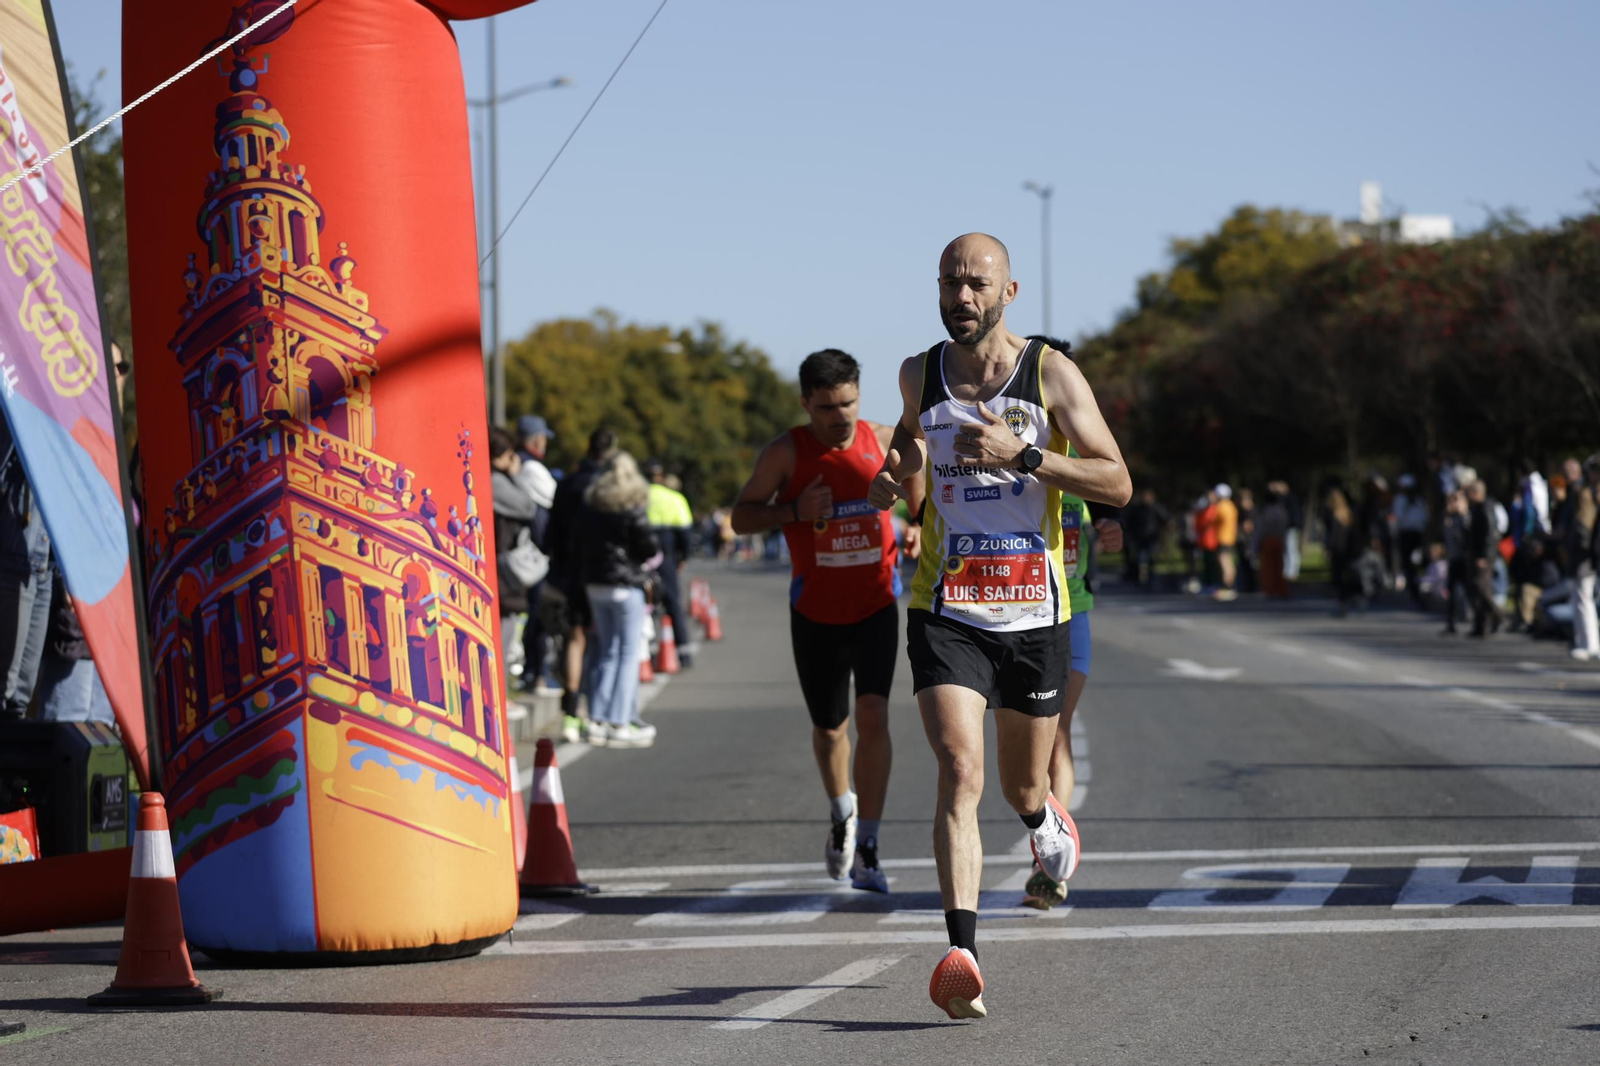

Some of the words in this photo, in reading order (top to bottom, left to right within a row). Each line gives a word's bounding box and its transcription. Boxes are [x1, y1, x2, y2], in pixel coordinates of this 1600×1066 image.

[966, 488, 998, 499] SWAG
[832, 534, 871, 552] MEGA
[979, 537, 1032, 551] ZURICH
[981, 564, 1011, 577] 1148
[944, 585, 979, 601] LUIS
[983, 584, 1046, 601] SANTOS
